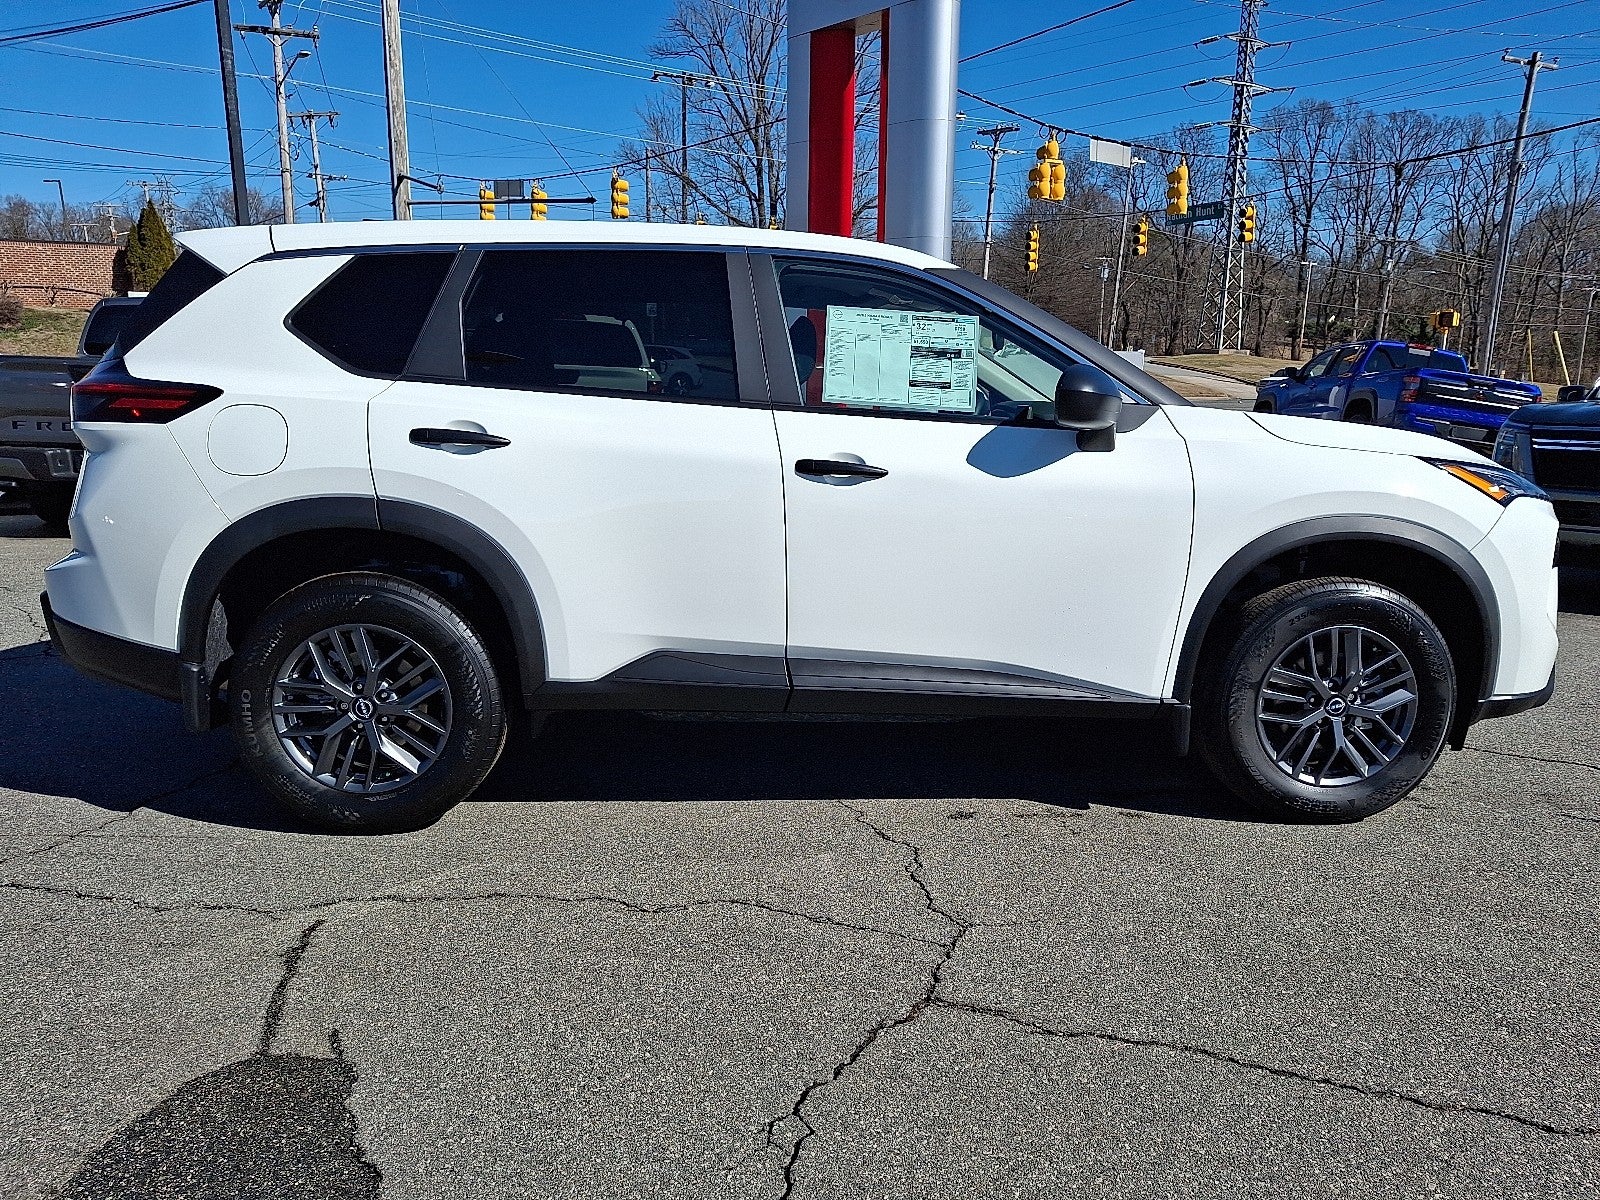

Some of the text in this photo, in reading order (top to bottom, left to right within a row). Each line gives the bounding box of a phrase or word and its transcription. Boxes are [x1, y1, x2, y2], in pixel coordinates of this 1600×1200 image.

[1196, 205, 1215, 216] Hunt
[916, 322, 927, 331] 32
[241, 689, 264, 757] KUMHO
